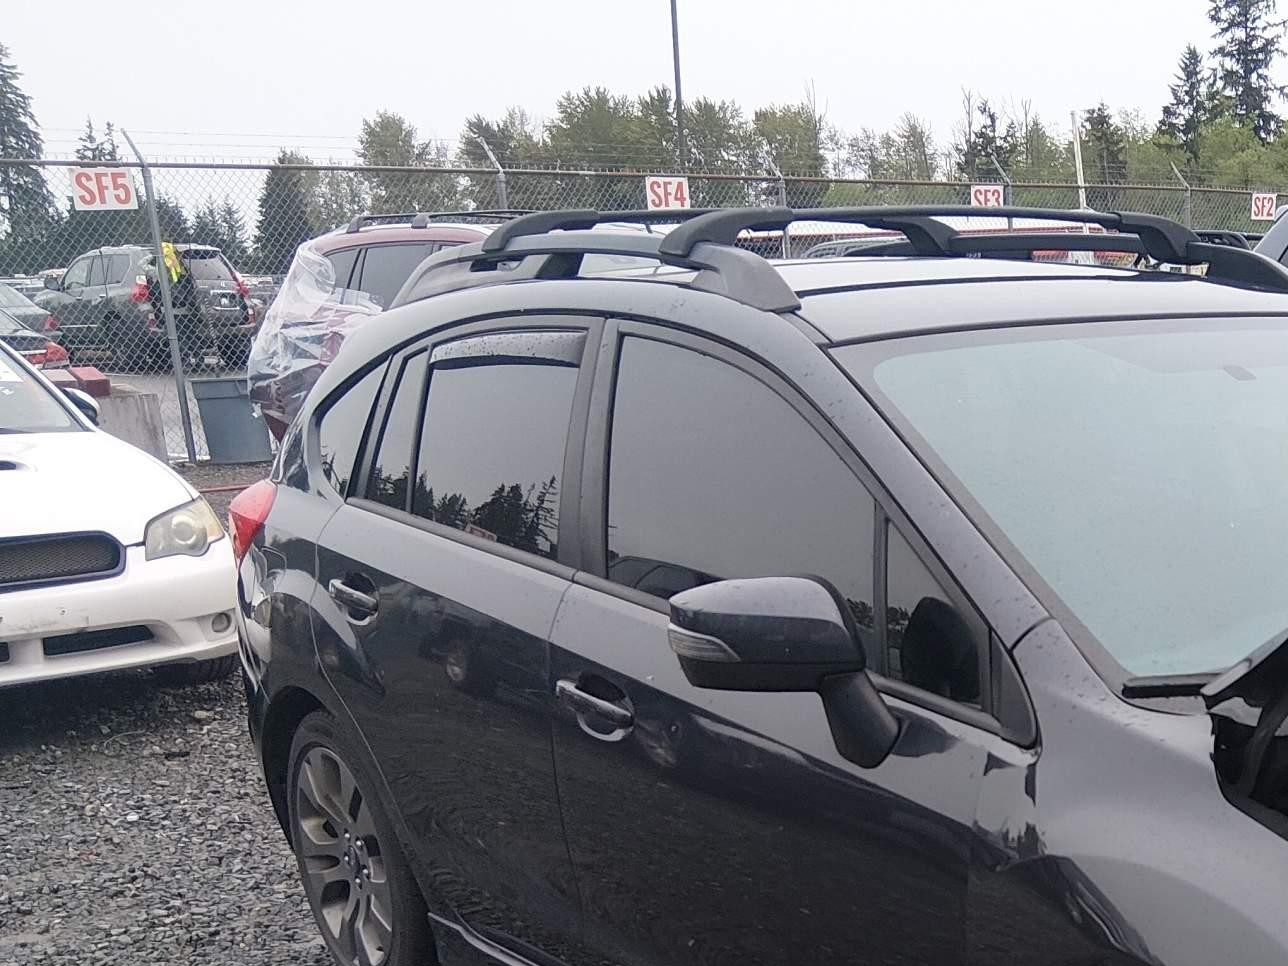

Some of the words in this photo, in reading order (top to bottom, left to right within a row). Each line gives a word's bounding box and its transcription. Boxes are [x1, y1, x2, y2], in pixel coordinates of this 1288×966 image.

[75, 172, 131, 205] SF5
[650, 180, 687, 208] SF4
[974, 189, 1001, 207] SF3
[1253, 196, 1274, 217] SF2
